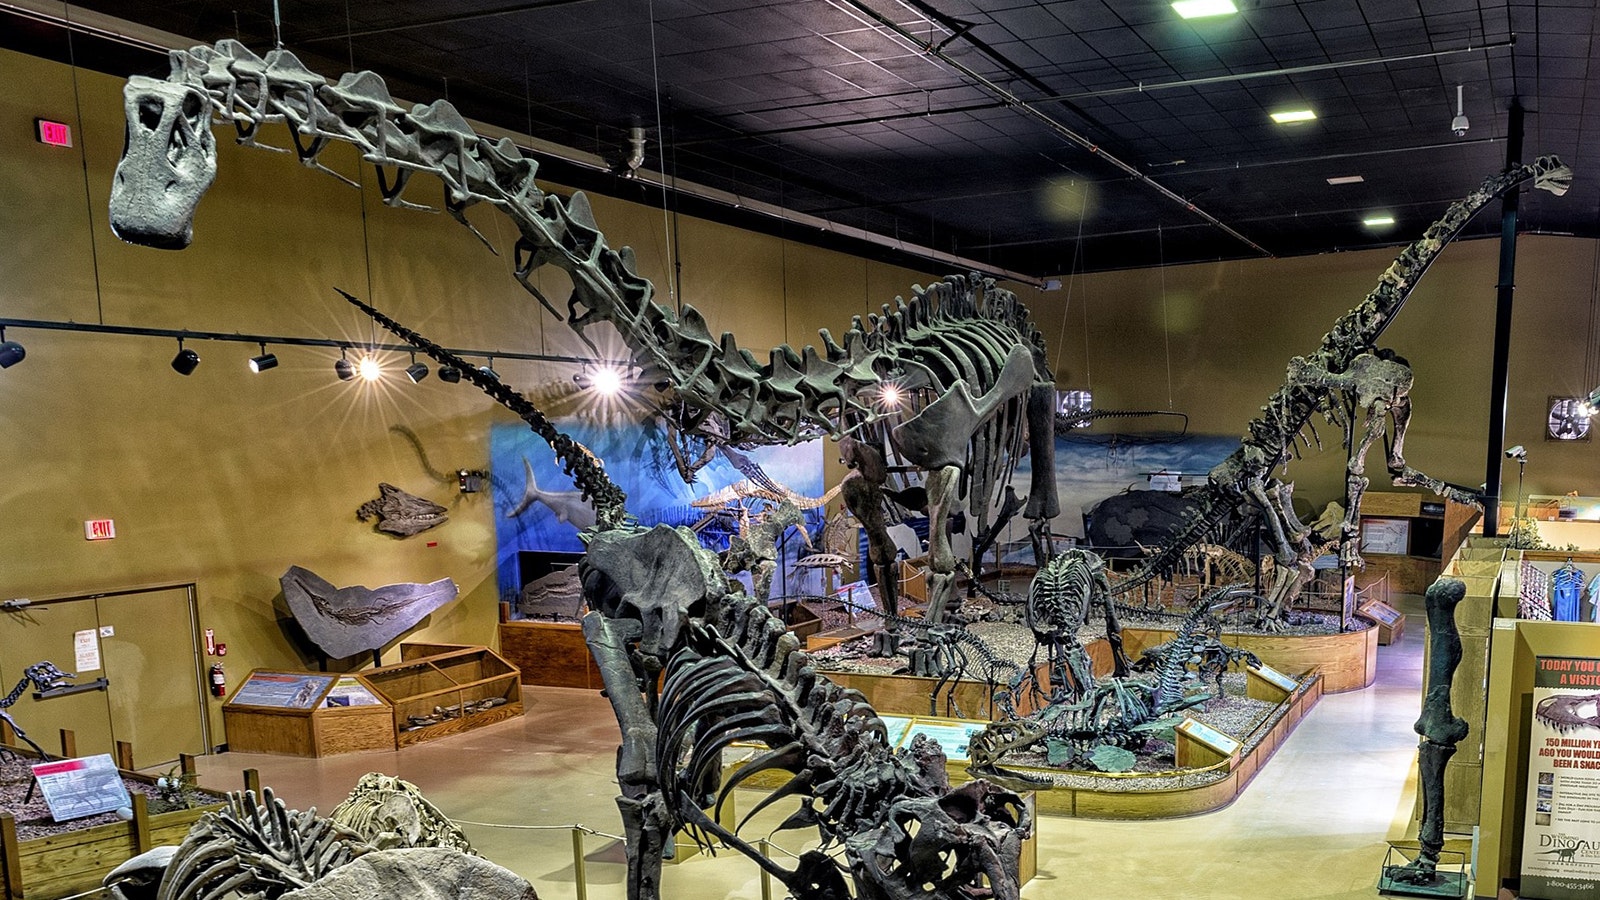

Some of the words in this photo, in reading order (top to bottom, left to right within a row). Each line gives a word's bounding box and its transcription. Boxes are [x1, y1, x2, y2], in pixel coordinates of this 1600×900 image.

[44, 123, 66, 144] EXIT
[92, 521, 111, 537] EXIT
[1540, 660, 1572, 672] TODAY
[1575, 661, 1594, 673] YOU
[1560, 674, 1567, 685] A
[1545, 738, 1559, 747] 150
[1561, 739, 1591, 748] MILLION
[1539, 748, 1555, 757] AGO
[1556, 749, 1572, 758] YOU
[1573, 750, 1600, 759] WOULD
[1553, 760, 1572, 769] BEEN
[1573, 761, 1578, 769] A
